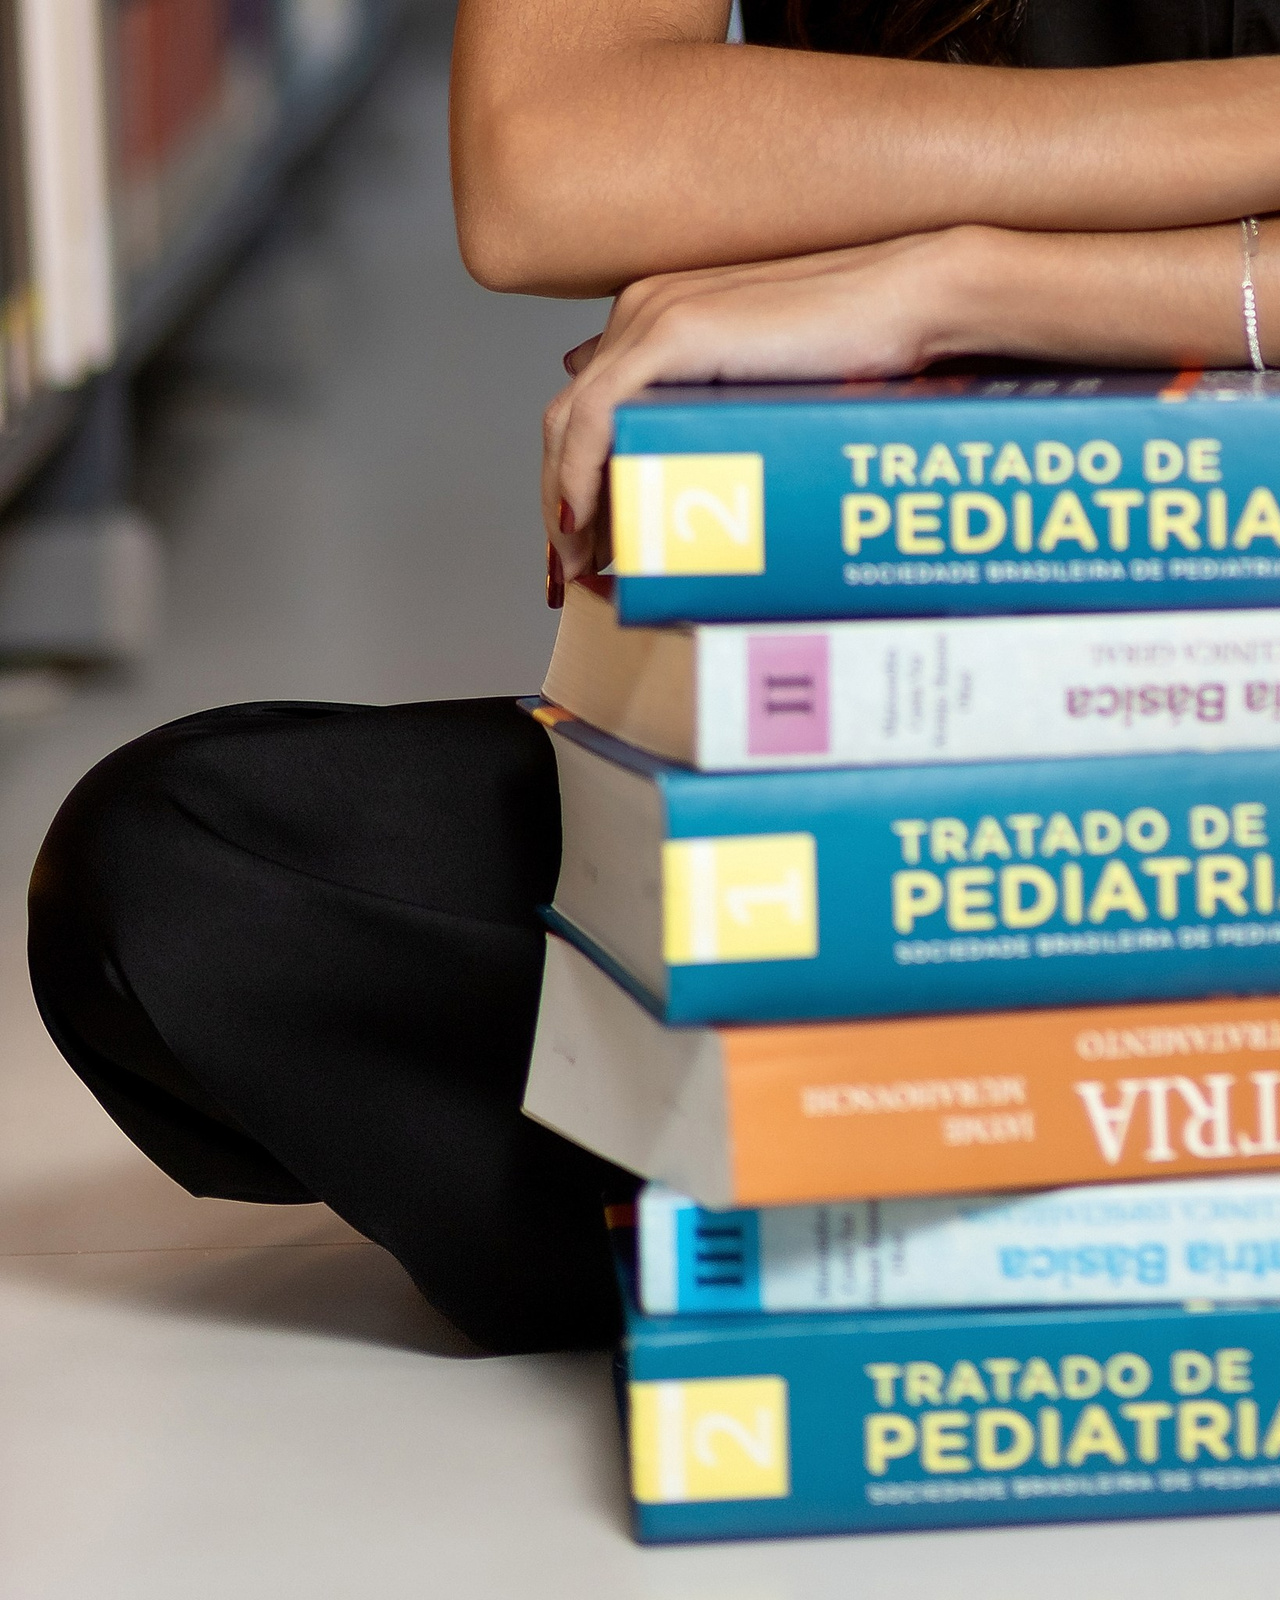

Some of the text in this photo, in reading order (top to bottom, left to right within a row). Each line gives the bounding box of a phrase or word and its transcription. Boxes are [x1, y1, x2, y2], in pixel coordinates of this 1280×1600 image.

[842, 437, 1222, 487] TRATADO DE
[671, 483, 750, 546] 2
[843, 561, 981, 587] SOCIEDADE
[984, 558, 1127, 584] BRASILEIRA
[1129, 557, 1165, 582] DE
[763, 674, 815, 716] II
[1065, 682, 1227, 726] Básica
[892, 801, 1268, 865] TRATADO DE
[722, 866, 803, 926] 1
[893, 937, 1032, 965] SOCIEDADE
[1177, 925, 1213, 950] DE
[694, 1225, 745, 1290] III
[865, 1347, 1253, 1408] TRATADO DE
[692, 1406, 776, 1468] 2
